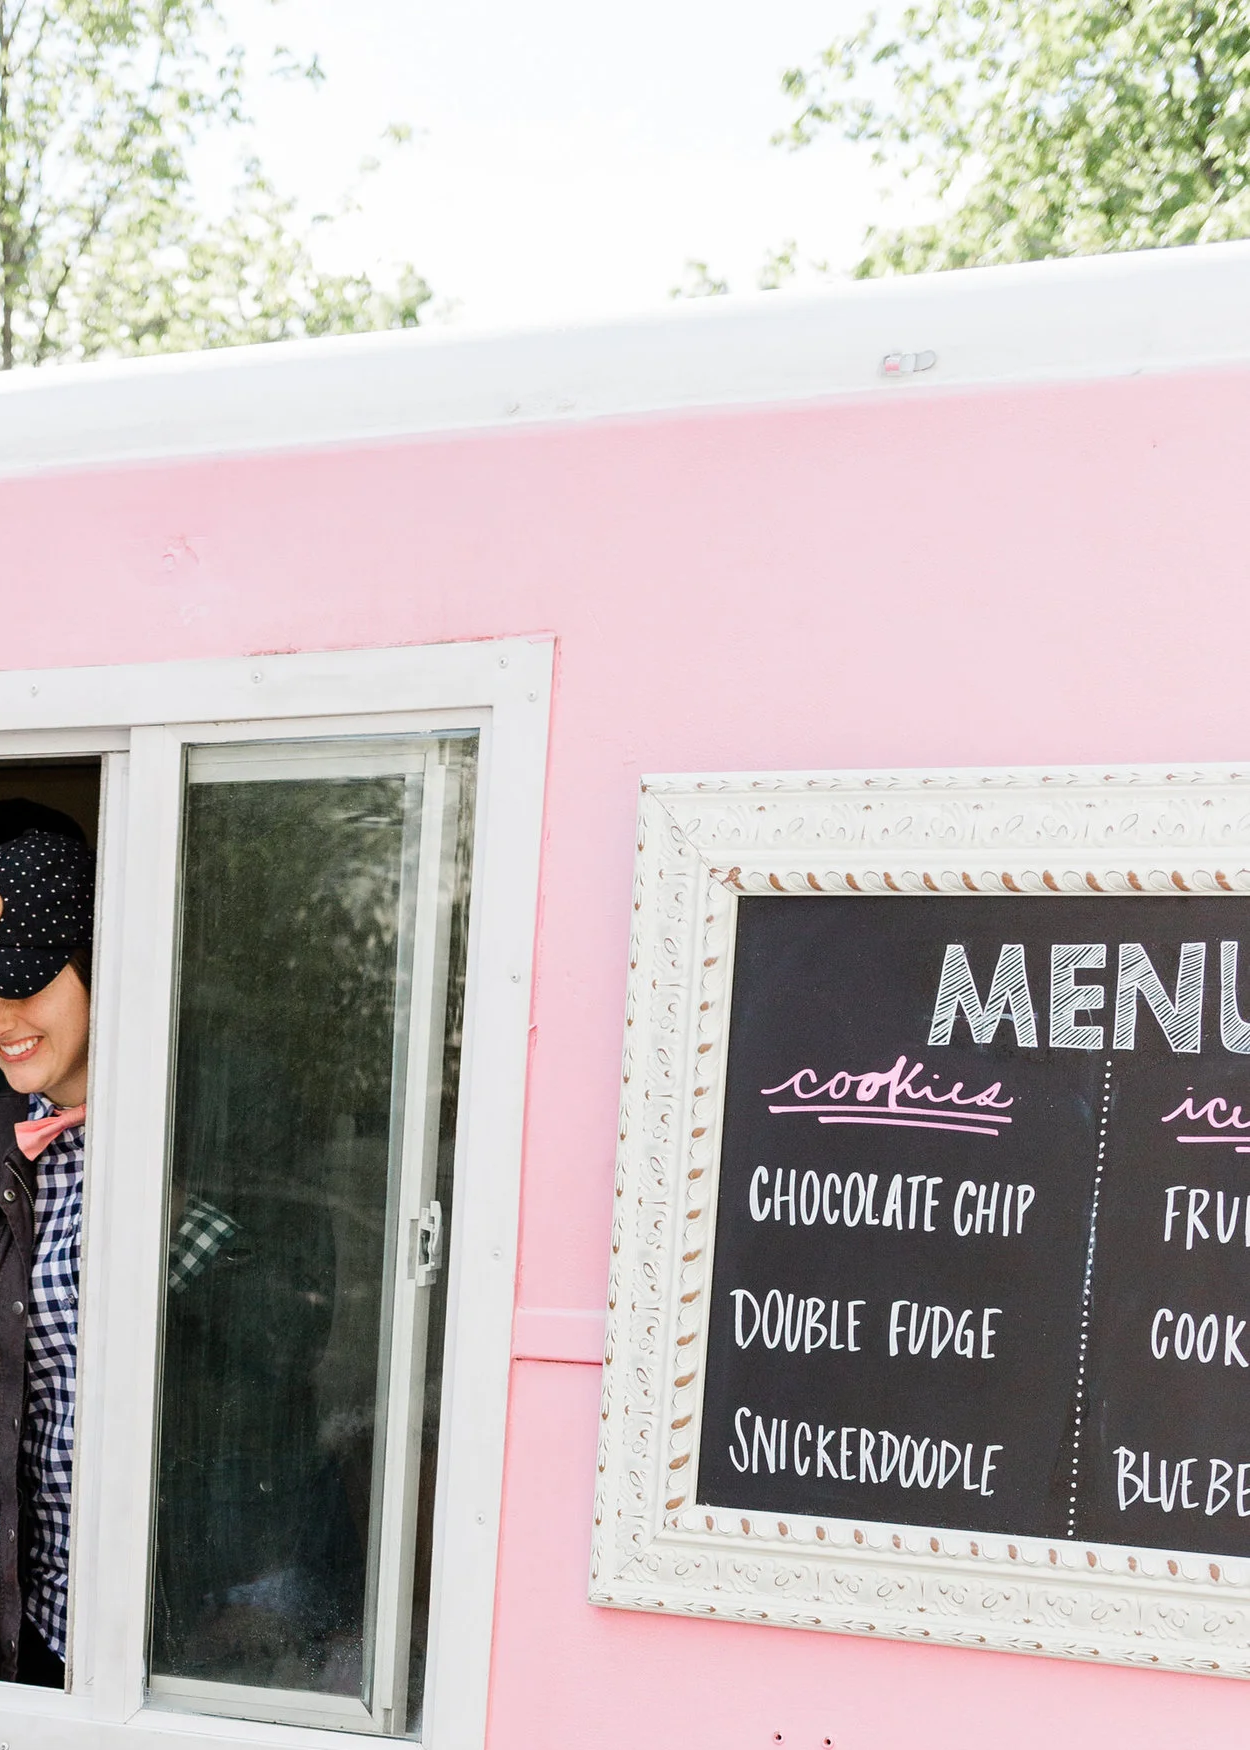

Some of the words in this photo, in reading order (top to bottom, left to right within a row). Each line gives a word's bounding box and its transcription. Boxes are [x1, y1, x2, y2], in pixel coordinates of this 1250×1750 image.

[761, 1055, 1014, 1111] cookies
[749, 1166, 943, 1232] CHOCOLATE
[953, 1180, 1036, 1237] CHIP
[730, 1289, 867, 1353] DOUBLE
[888, 1300, 1003, 1359] FUDGE
[1151, 1308, 1250, 1367] COOK
[729, 1407, 1003, 1496] SNICKERDOODLE
[1112, 1446, 1250, 1517] BLUEBE
